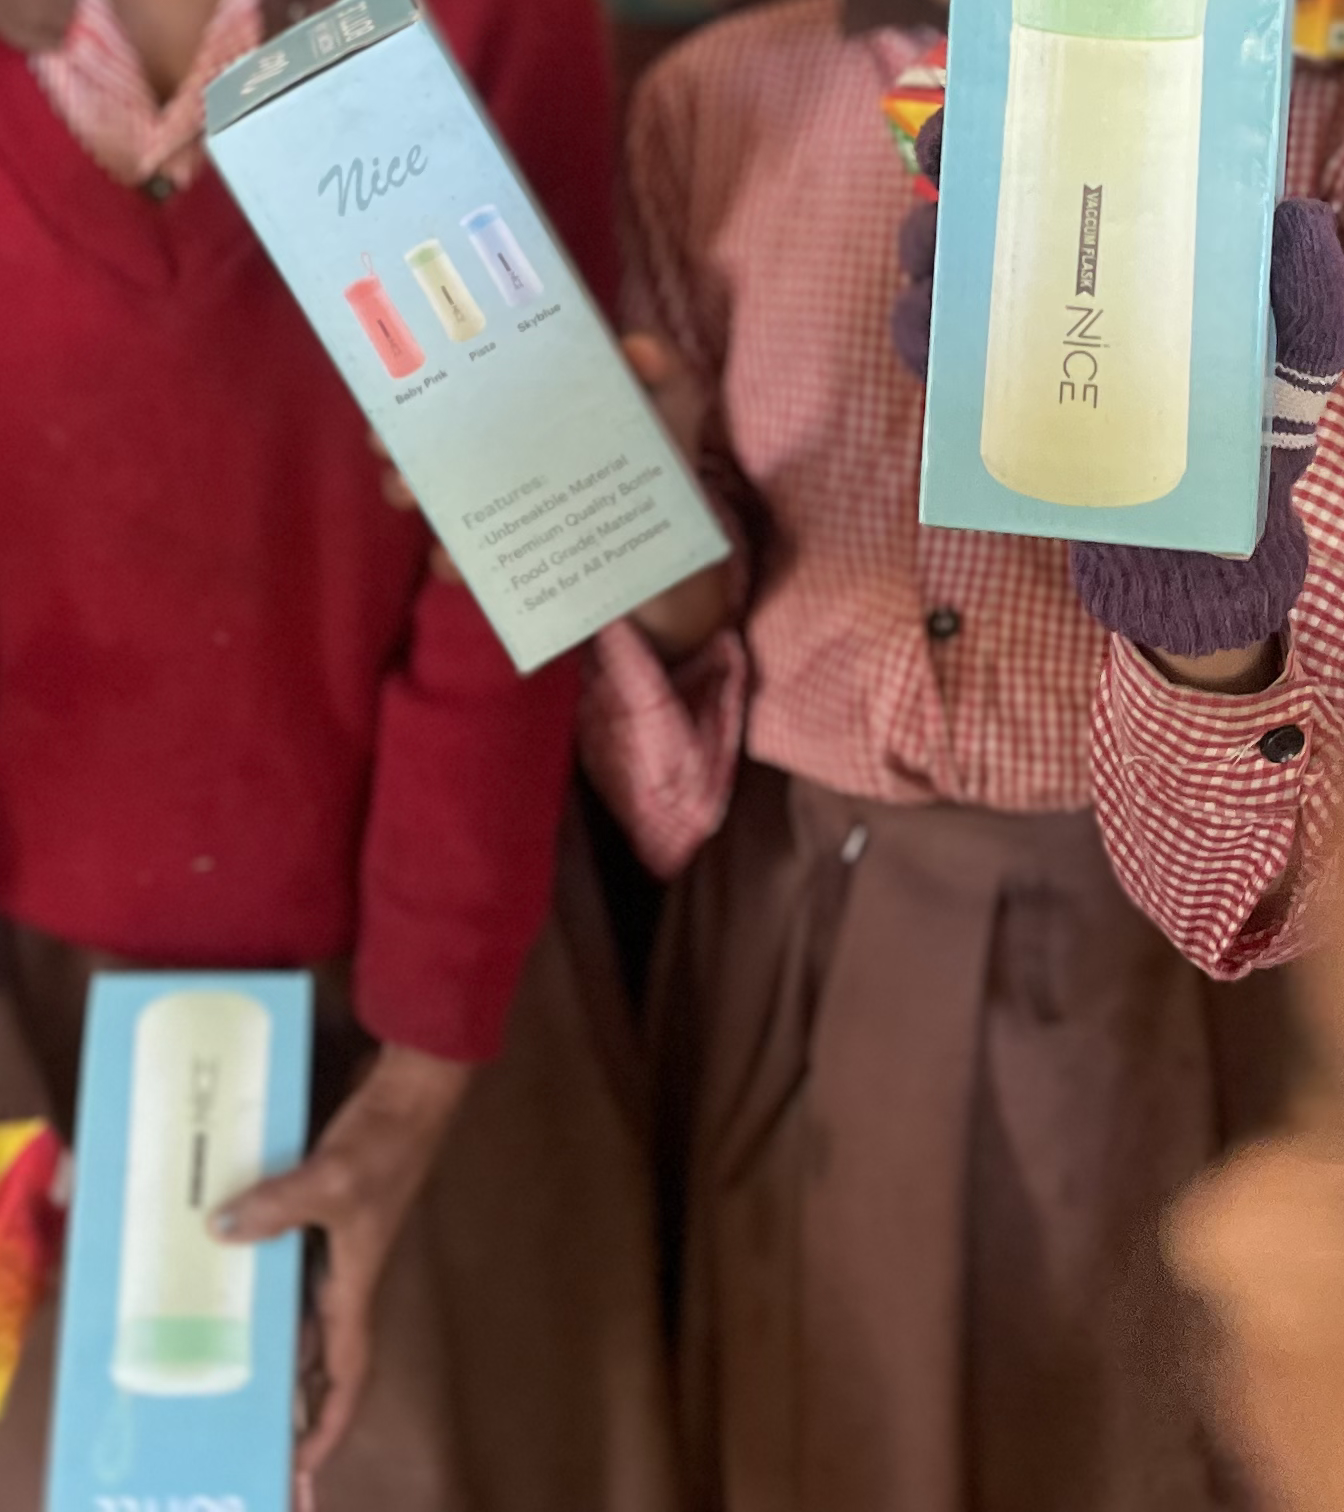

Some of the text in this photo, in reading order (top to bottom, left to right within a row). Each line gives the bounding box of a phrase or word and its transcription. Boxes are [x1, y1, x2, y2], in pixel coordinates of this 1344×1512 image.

[317, 143, 429, 217] Nice
[1079, 191, 1100, 290] VACCUM FLASK
[516, 302, 562, 333] Skyblue
[496, 521, 564, 568] Premium
[562, 489, 619, 529] Quality
[509, 559, 550, 590] Food
[557, 571, 581, 591] for
